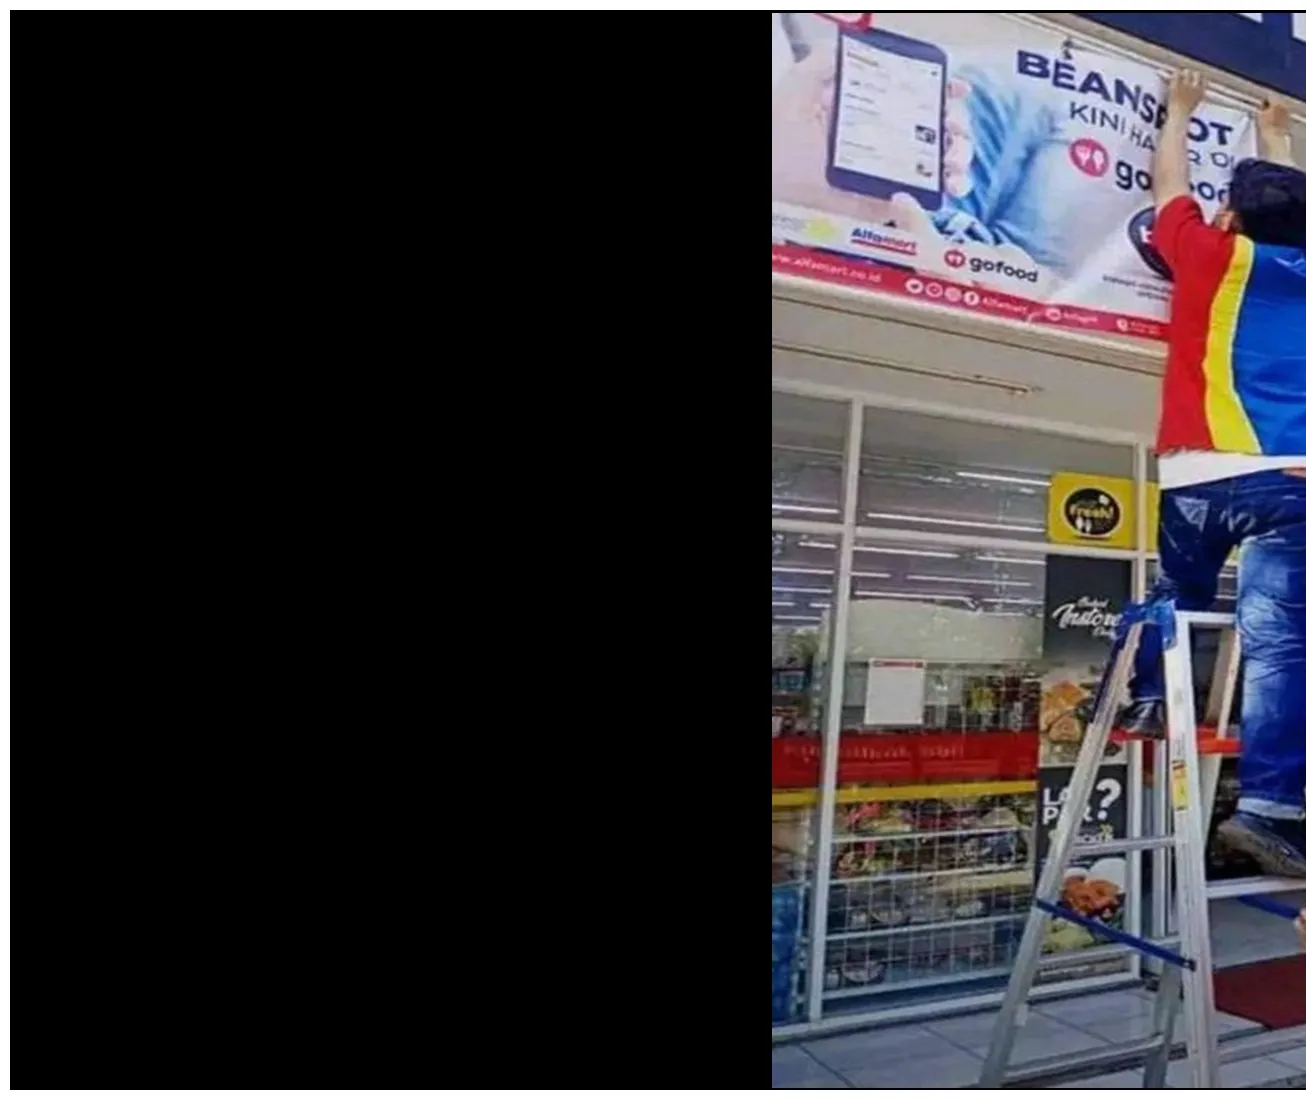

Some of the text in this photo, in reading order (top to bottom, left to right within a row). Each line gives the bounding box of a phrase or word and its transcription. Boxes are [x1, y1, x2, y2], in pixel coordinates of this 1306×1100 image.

[1069, 101, 1126, 135] KINI
[852, 227, 918, 250] Alfamart
[969, 256, 1039, 284] gofood
